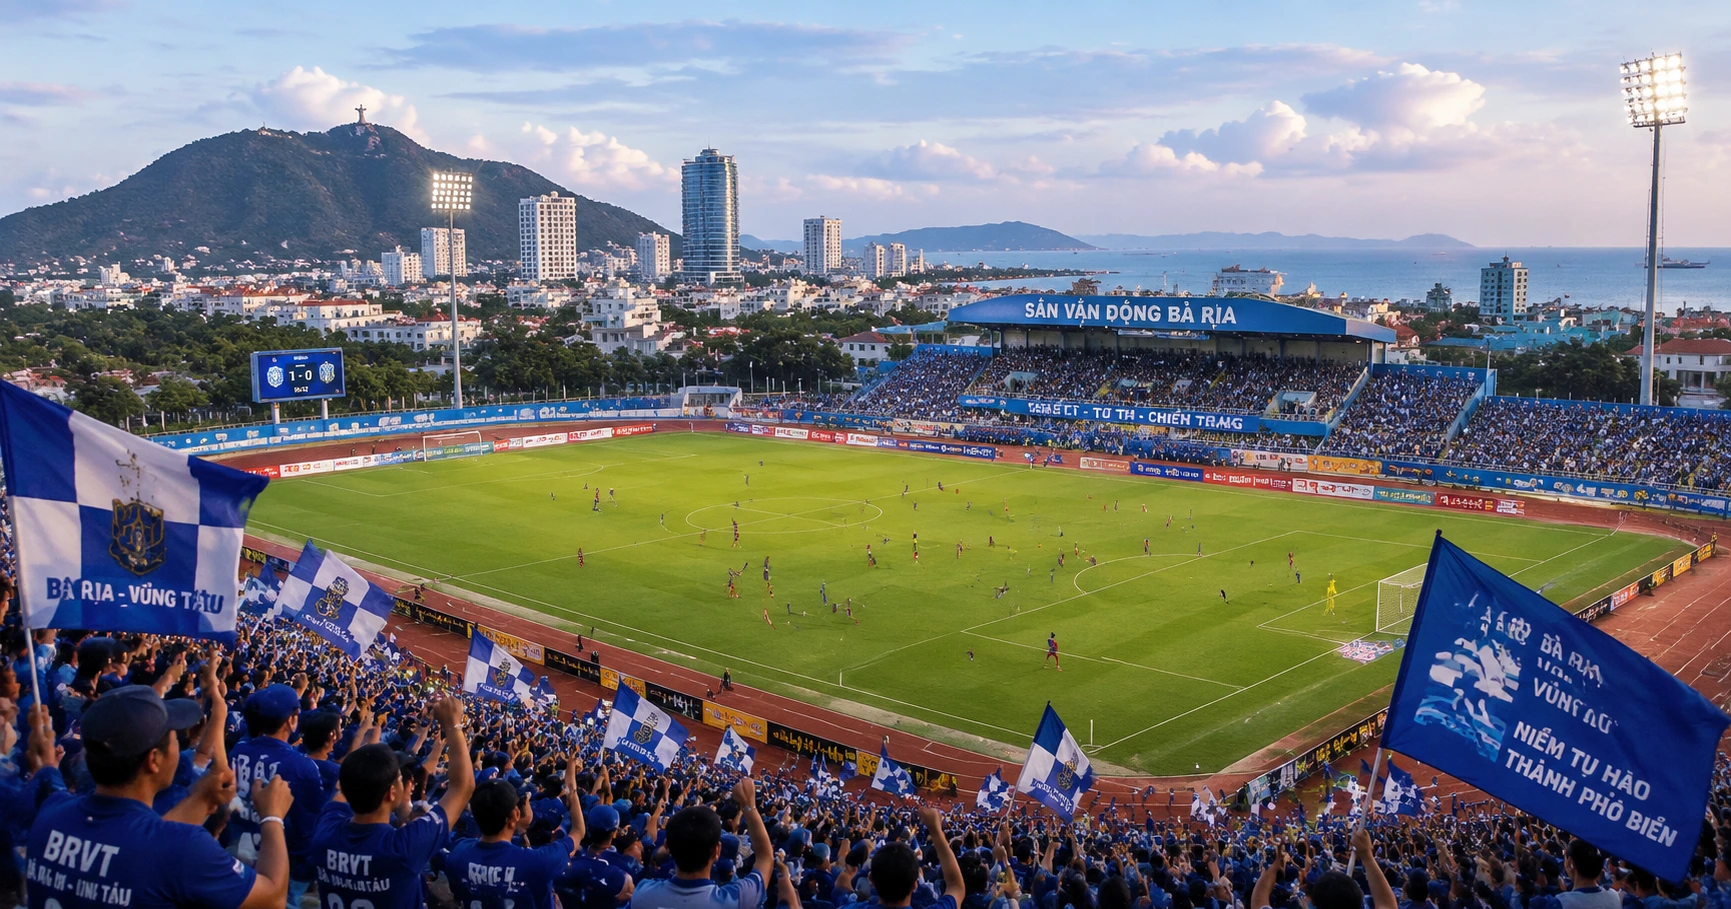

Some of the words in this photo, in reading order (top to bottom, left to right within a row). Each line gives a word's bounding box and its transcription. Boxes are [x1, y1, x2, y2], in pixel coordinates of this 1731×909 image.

[289, 371, 295, 381] 1
[305, 370, 312, 381] 0
[43, 829, 121, 878] BRVT
[327, 849, 372, 876] BRVT
